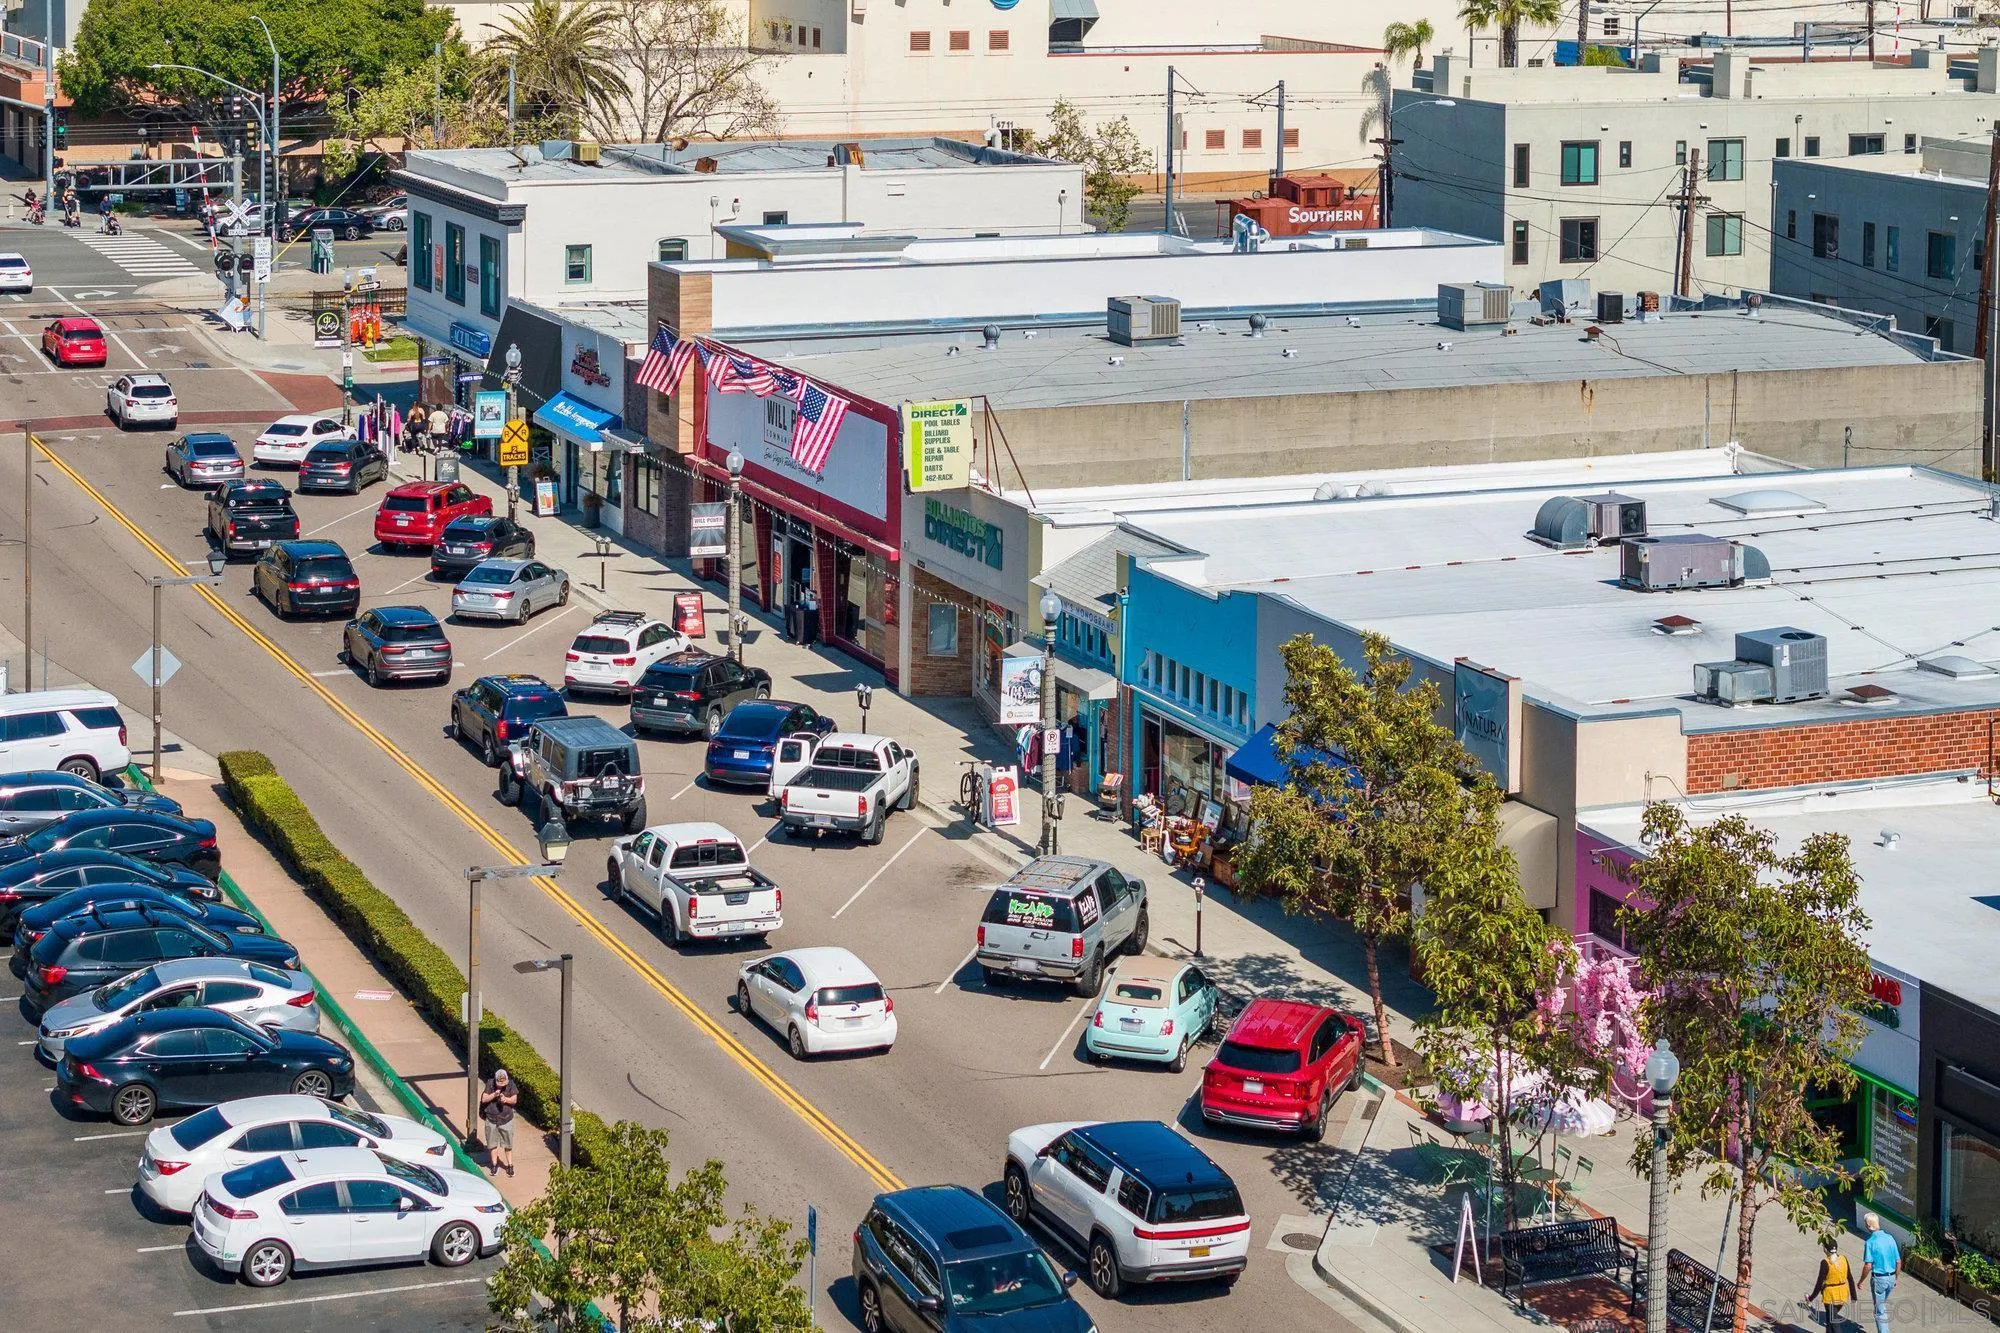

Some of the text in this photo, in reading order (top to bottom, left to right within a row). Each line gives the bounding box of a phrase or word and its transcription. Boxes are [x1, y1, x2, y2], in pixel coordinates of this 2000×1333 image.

[1288, 206, 1363, 223] SOUTHERN
[72, 375, 116, 389] CLE
[767, 399, 787, 431] WILL
[912, 409, 956, 418] DIRECT
[940, 418, 960, 426] TABLES
[925, 429, 949, 437] BILLIARD
[925, 437, 950, 445] SUPPLIES
[925, 496, 987, 539] BILLIARDS
[925, 513, 986, 562] DIRECT
[1074, 603, 1114, 632] MONOGRAMS
[1465, 710, 1505, 741] NATURA
[1181, 1236, 1222, 1245] RIVIAN
